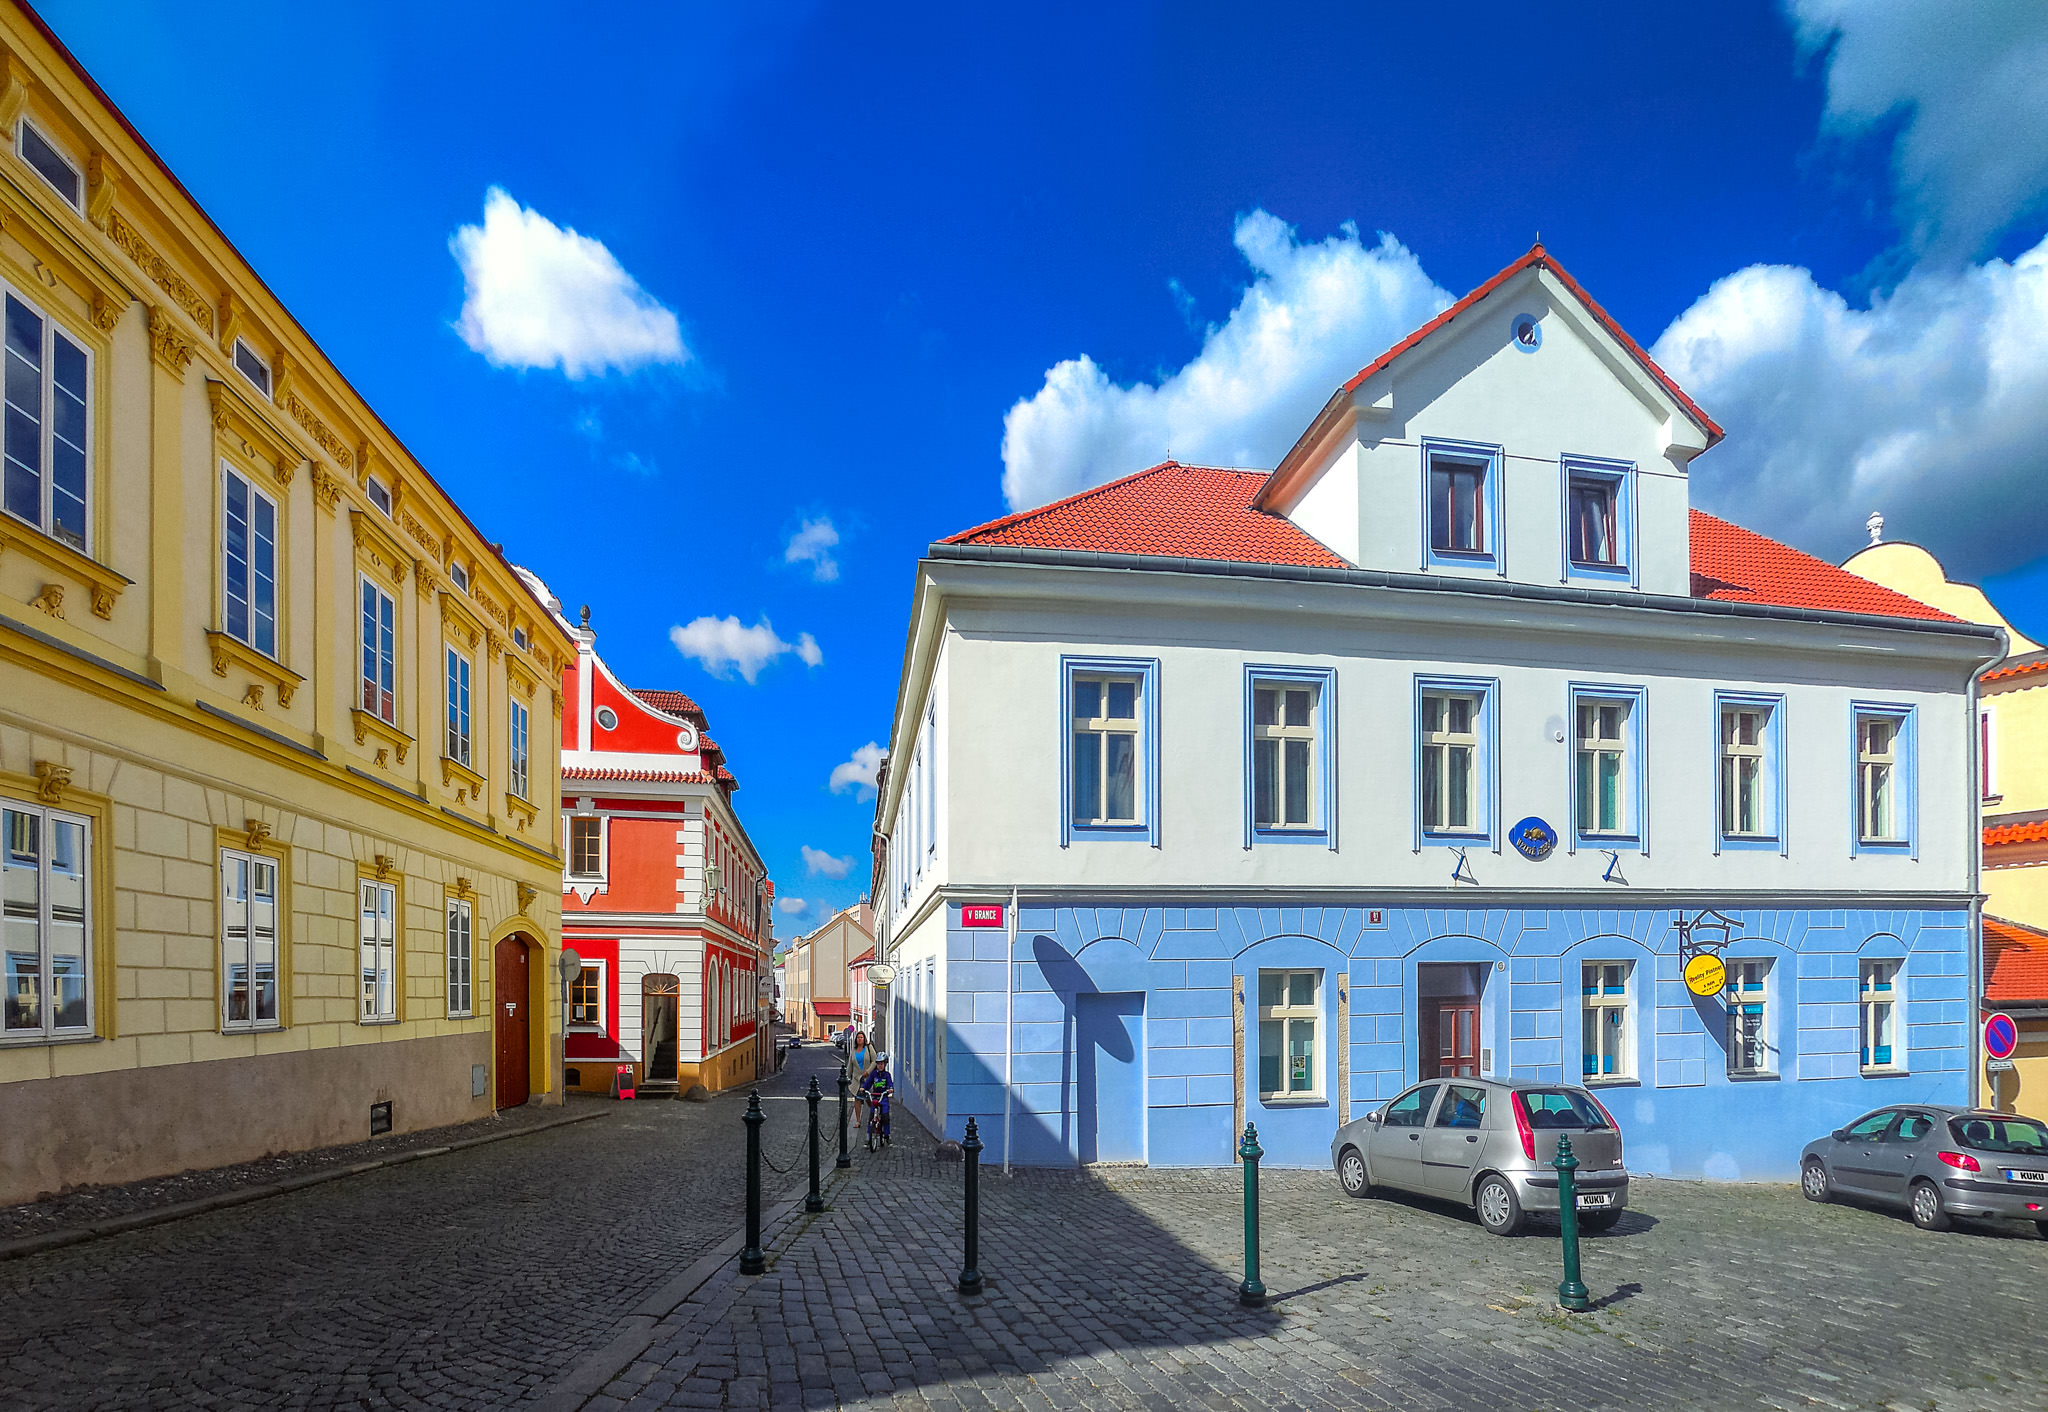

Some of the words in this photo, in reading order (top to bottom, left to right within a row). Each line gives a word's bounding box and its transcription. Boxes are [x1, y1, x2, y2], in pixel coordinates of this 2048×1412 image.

[968, 910, 973, 920] V
[975, 910, 997, 920] BRANCE
[2020, 1171, 2045, 1181] KUKU
[1583, 1195, 1605, 1205] KUKU
